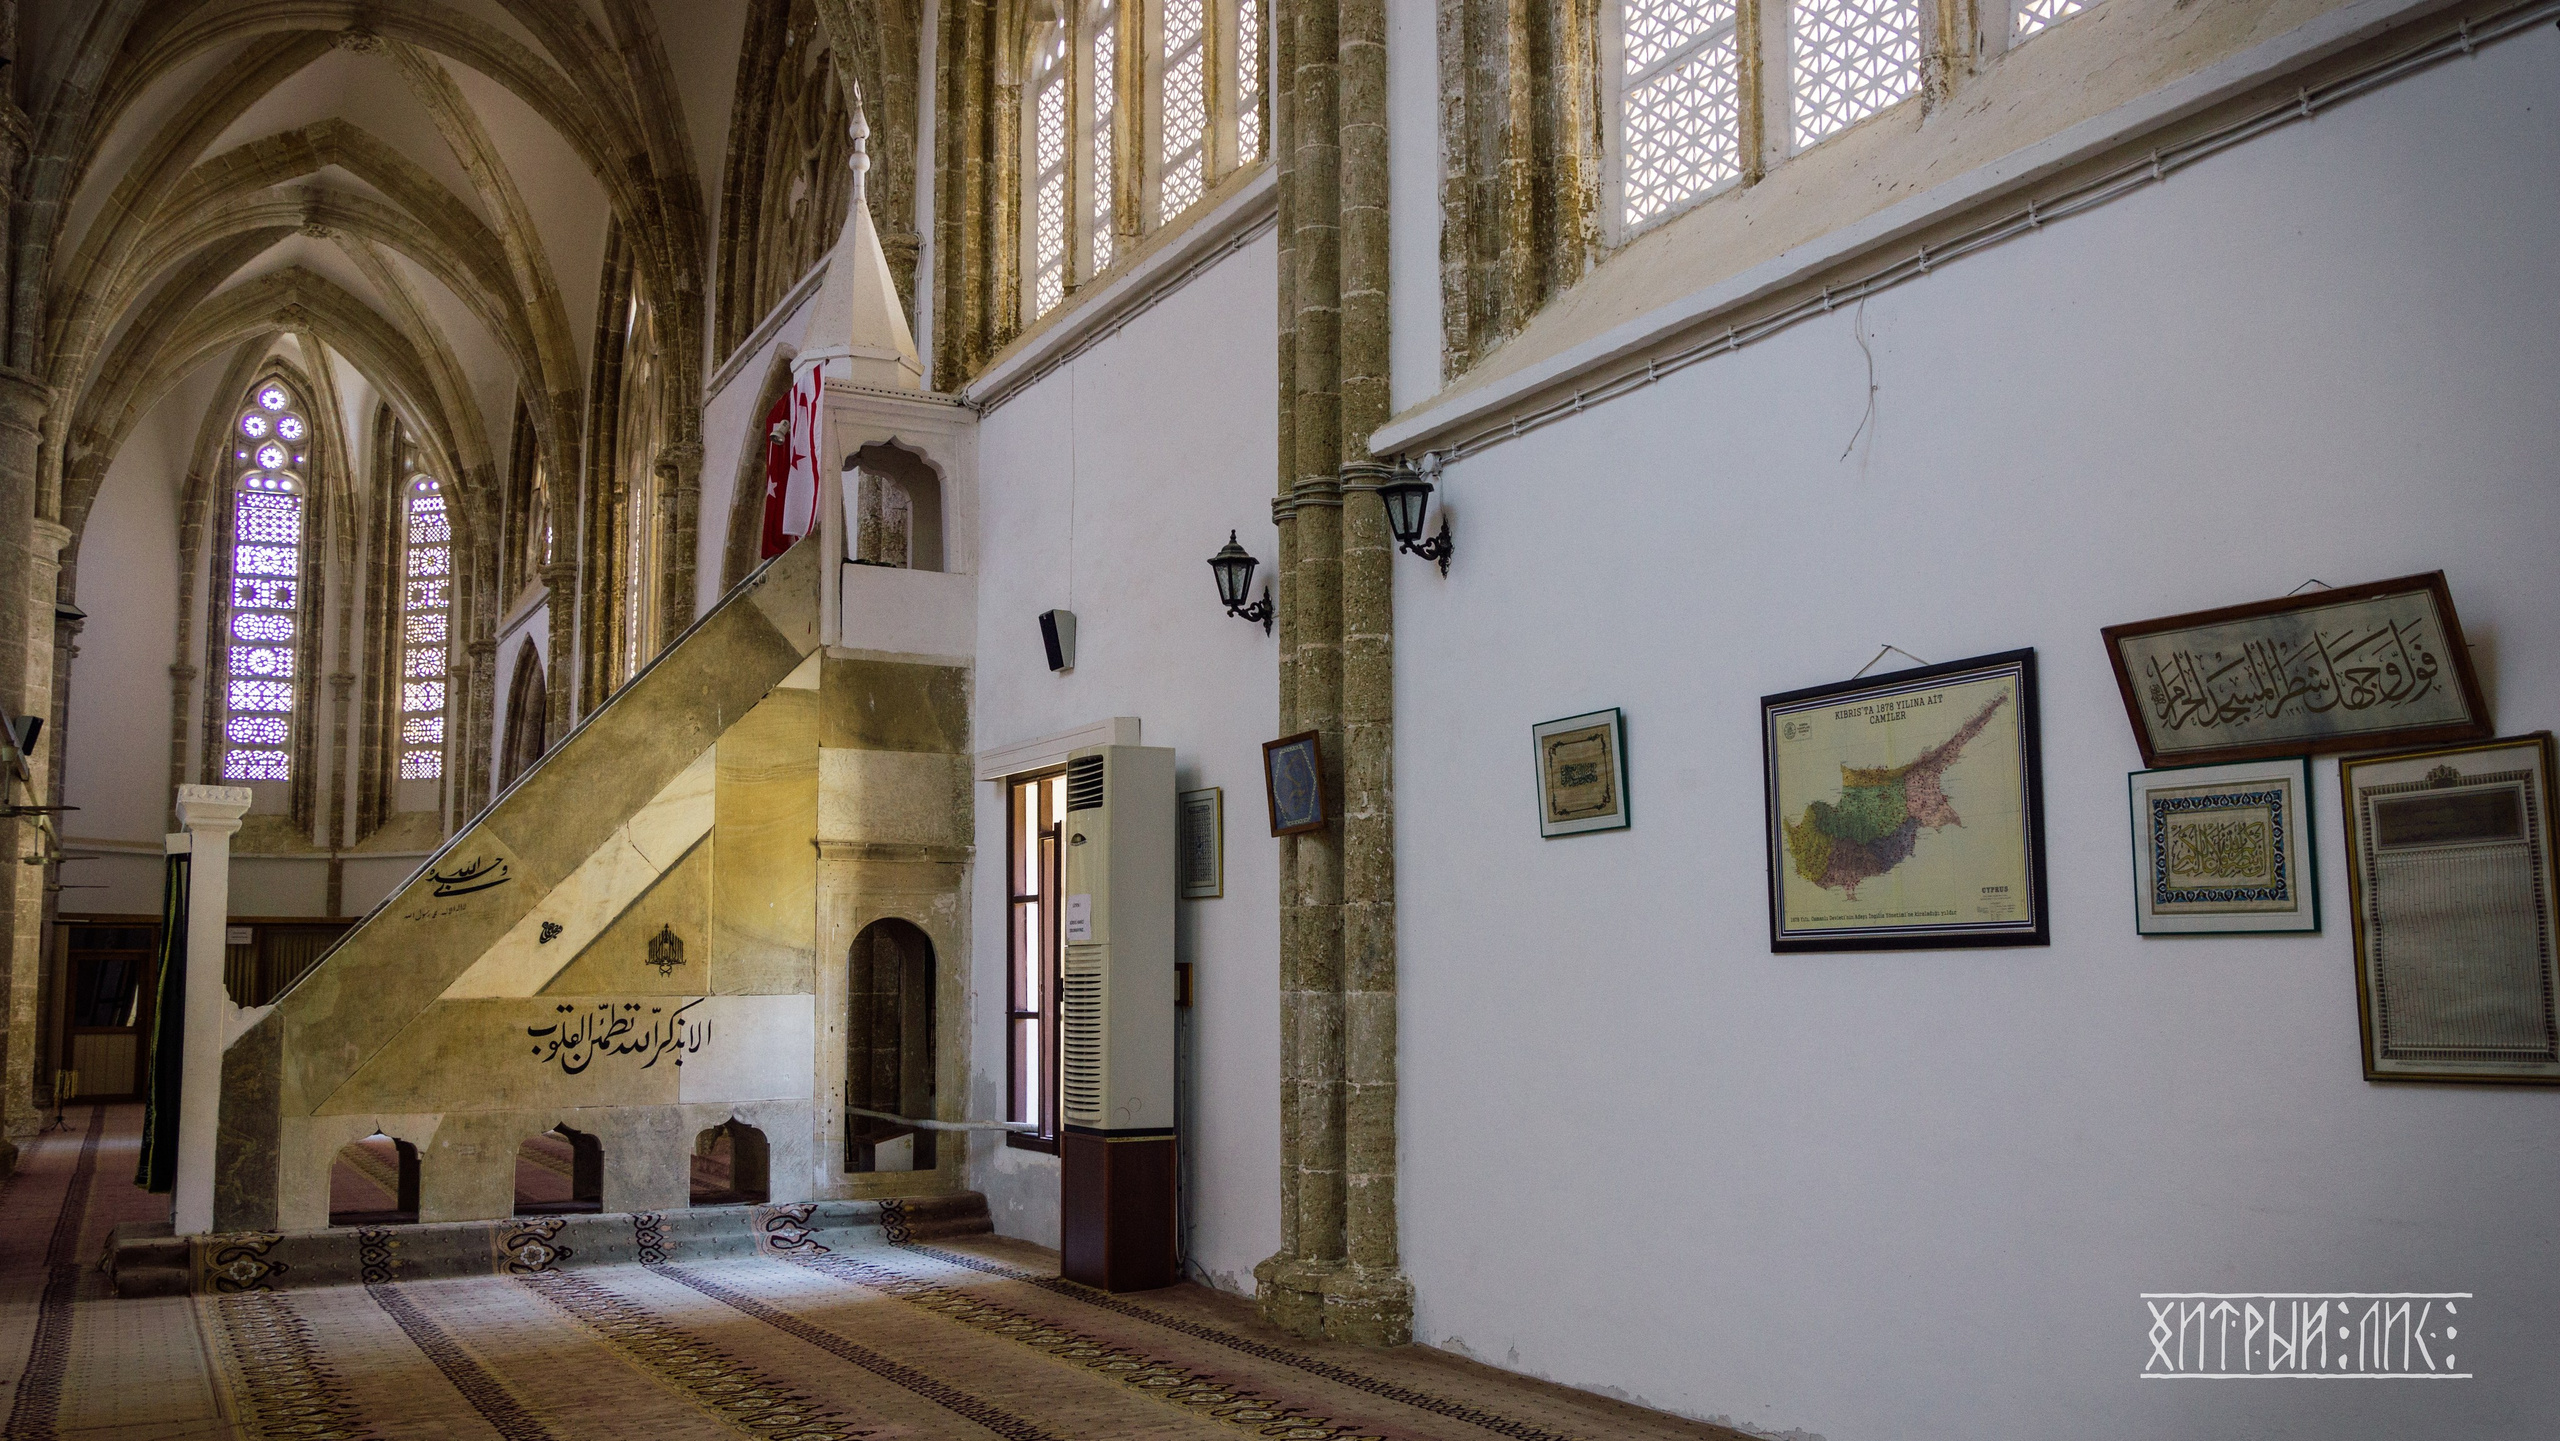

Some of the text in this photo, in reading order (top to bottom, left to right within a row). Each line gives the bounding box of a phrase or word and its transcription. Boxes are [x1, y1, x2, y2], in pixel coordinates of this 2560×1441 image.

[1876, 702, 1894, 713] 1878
[1896, 697, 1925, 709] YILINA
[1927, 694, 1943, 705] AİT
[1869, 711, 1906, 724] CAMİLER
